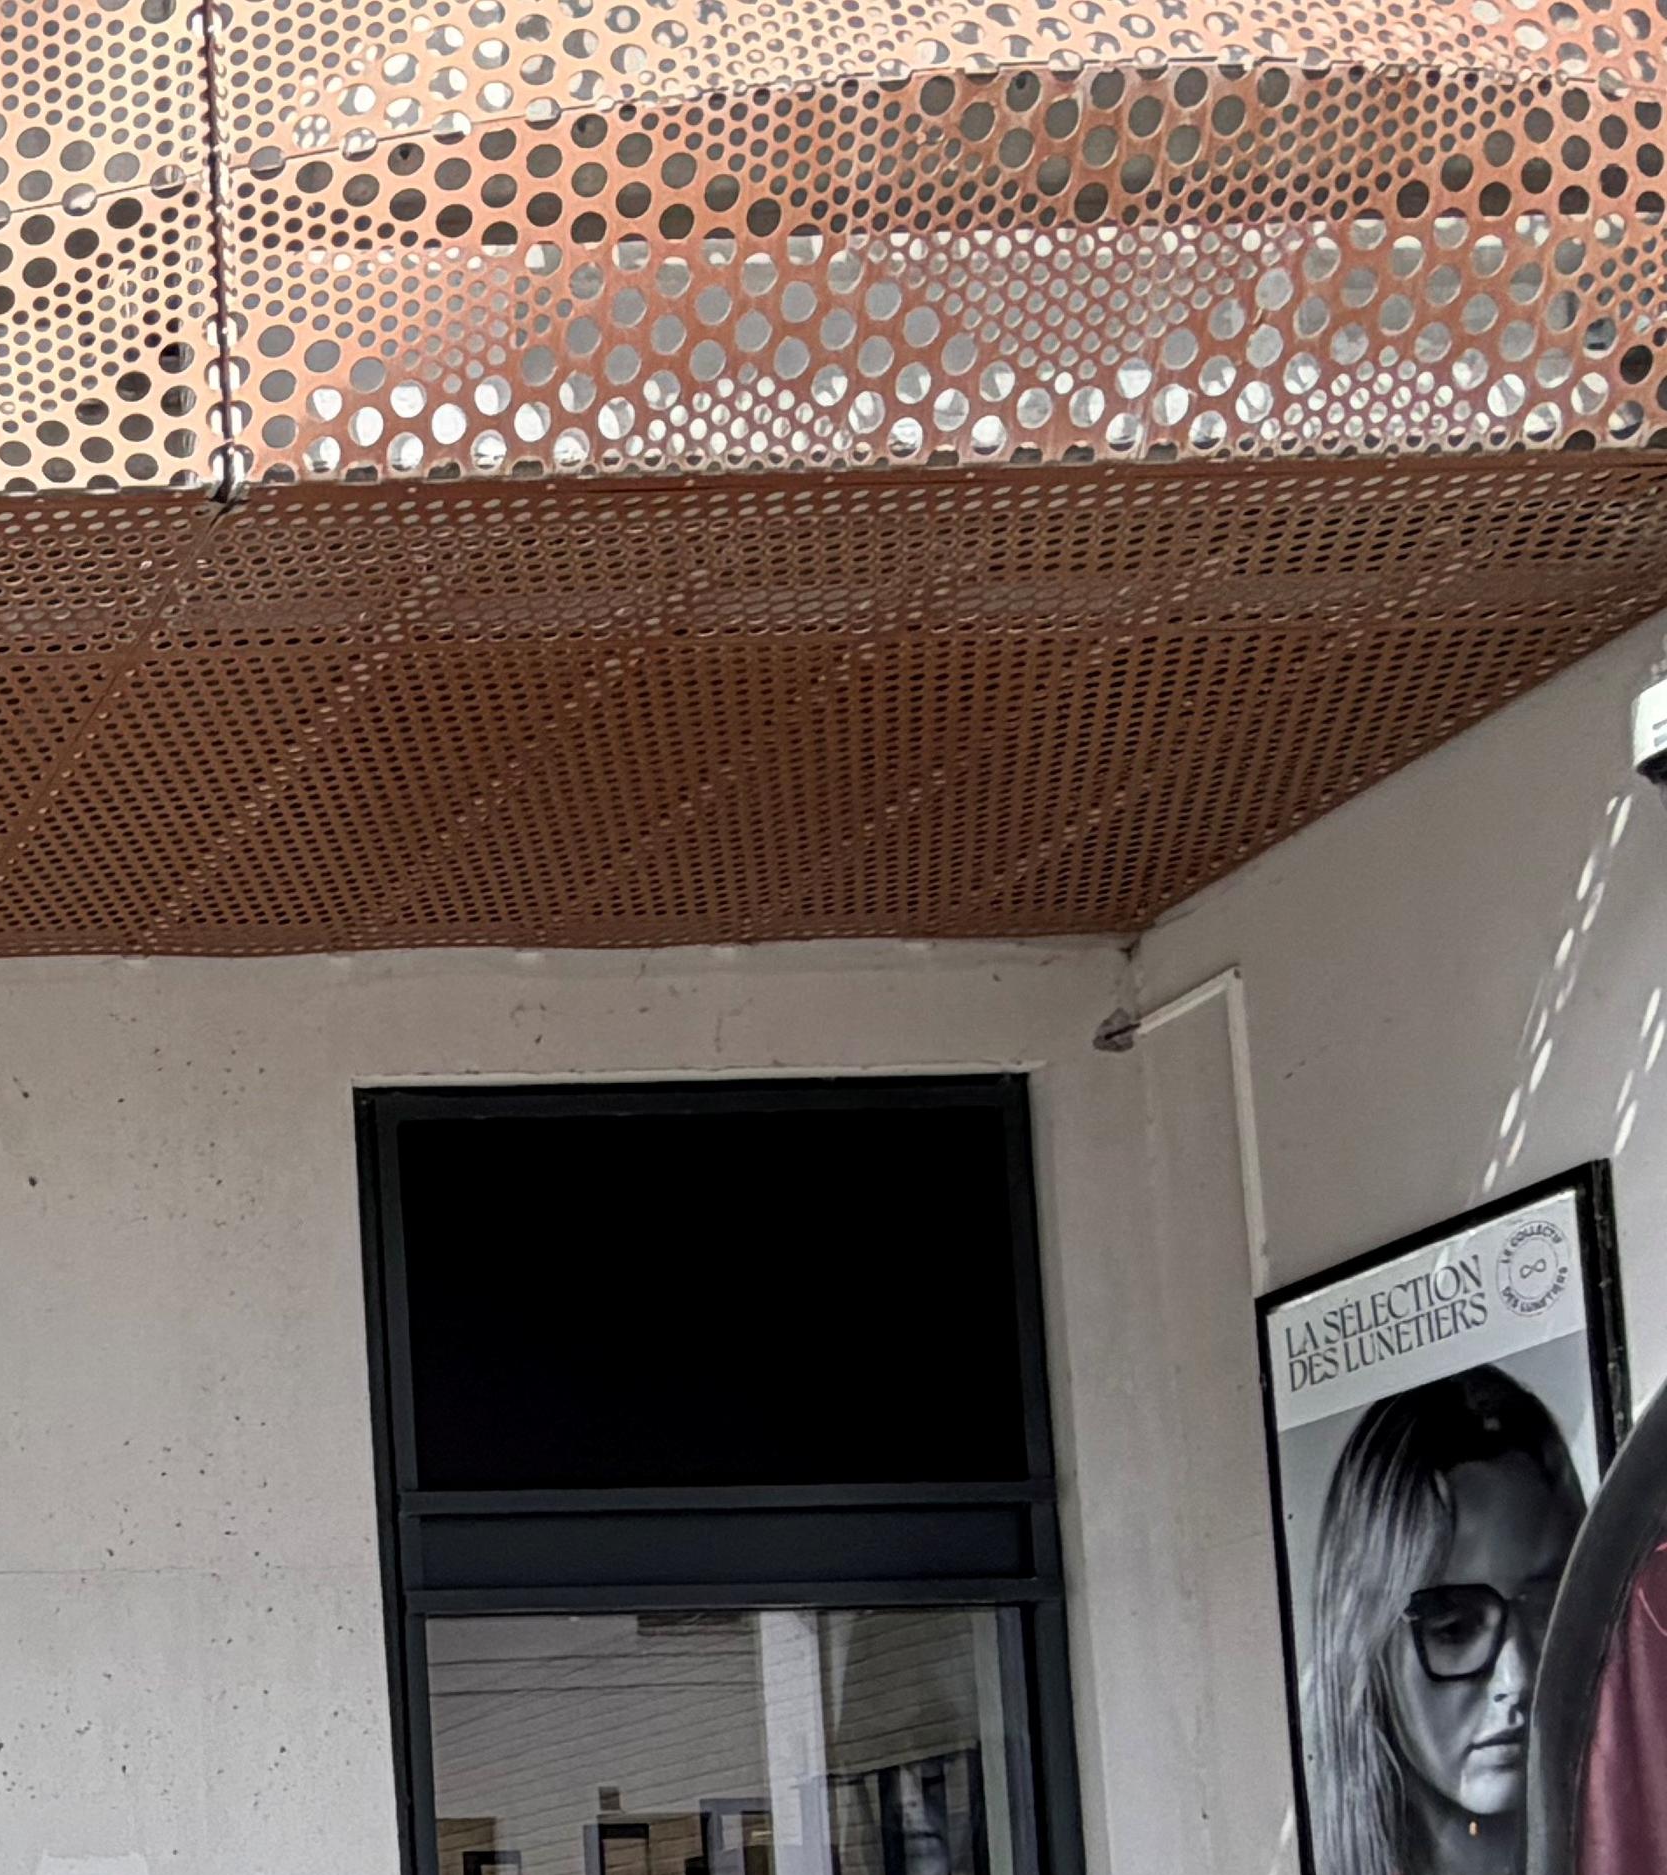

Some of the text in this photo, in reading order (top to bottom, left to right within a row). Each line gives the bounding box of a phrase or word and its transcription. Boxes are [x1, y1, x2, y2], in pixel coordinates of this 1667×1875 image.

[1286, 1255, 1485, 1359] LA SÉLECTION
[1289, 1293, 1489, 1393] DES LUNETIERS
